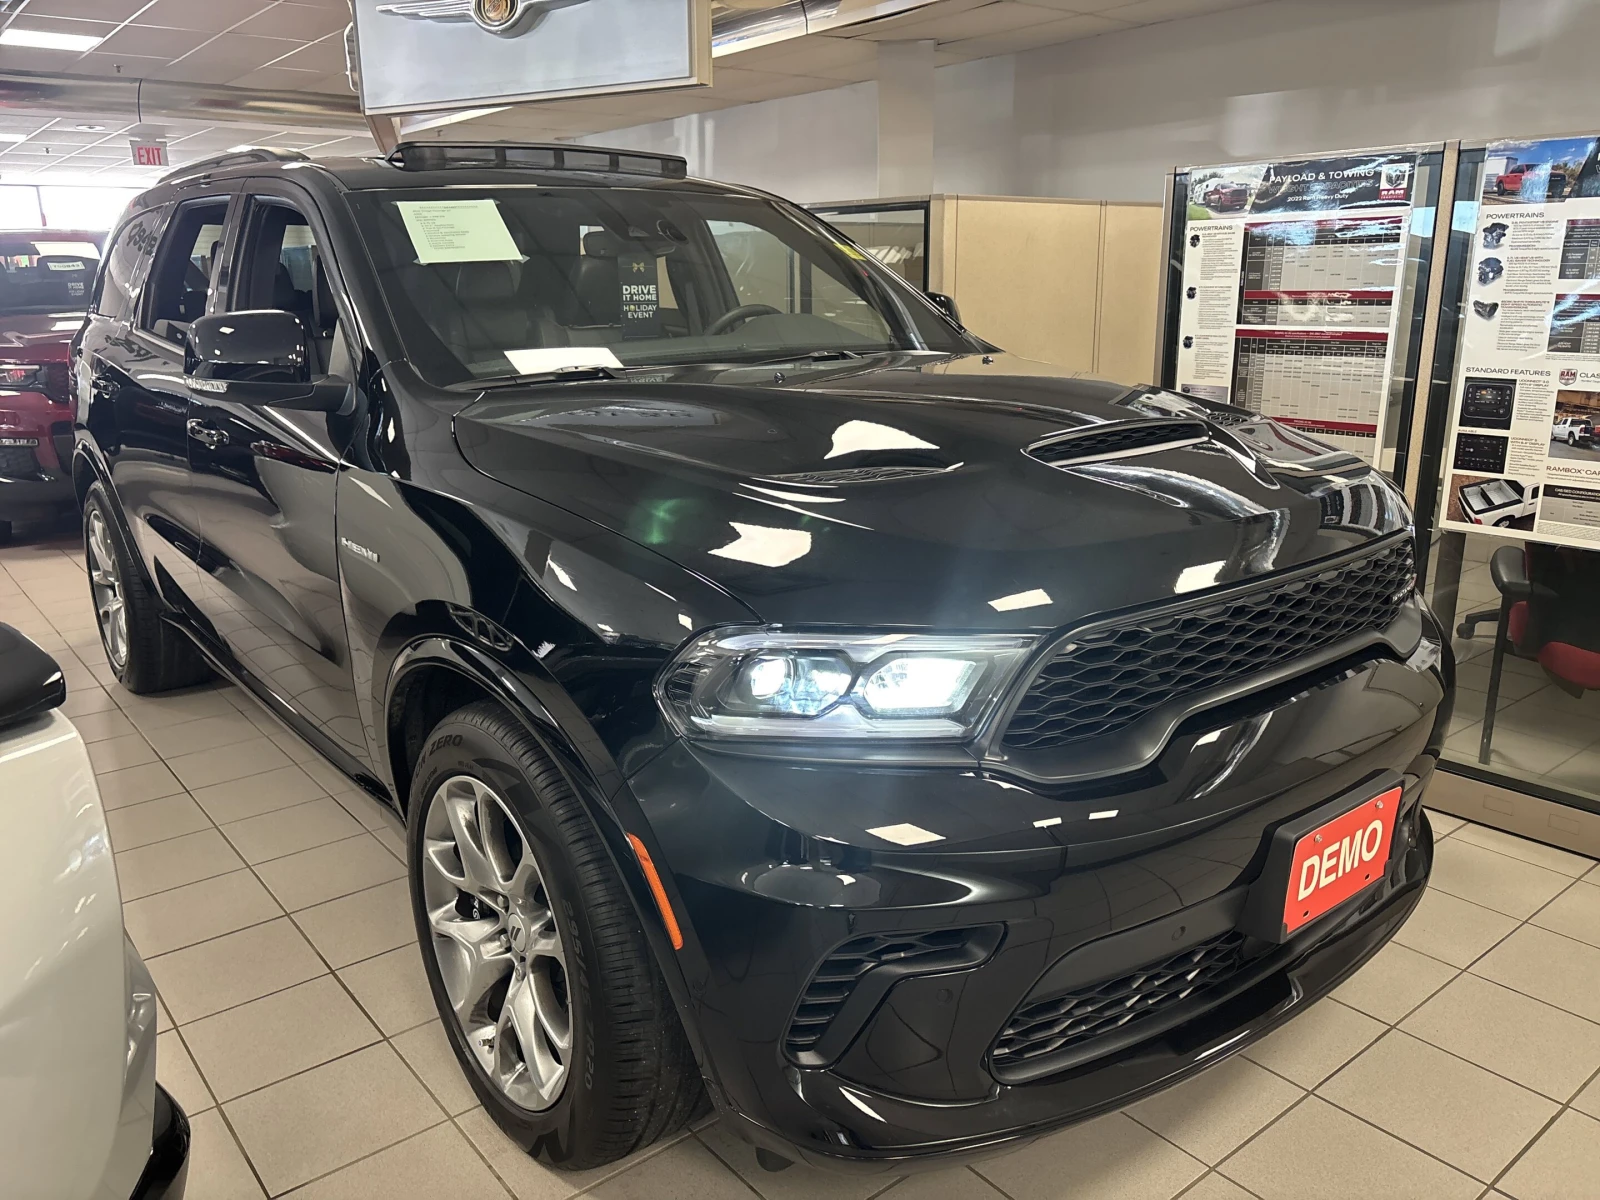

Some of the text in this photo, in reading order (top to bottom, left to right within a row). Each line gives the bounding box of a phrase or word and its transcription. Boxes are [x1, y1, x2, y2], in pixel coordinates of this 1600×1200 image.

[137, 147, 162, 165] EXIT
[1269, 168, 1375, 184] PAYLOAD & TOWING
[1486, 212, 1545, 220] POWERTRAINS
[622, 285, 657, 294] DRIVE
[623, 304, 657, 312] HOLIDAY
[628, 311, 654, 319] EVENT
[1465, 366, 1552, 377] STANDARD FEATURES
[1560, 368, 1576, 378] RAM
[341, 537, 378, 563] HEMI
[429, 734, 464, 757] ZERO
[1297, 819, 1383, 902] DEMO
